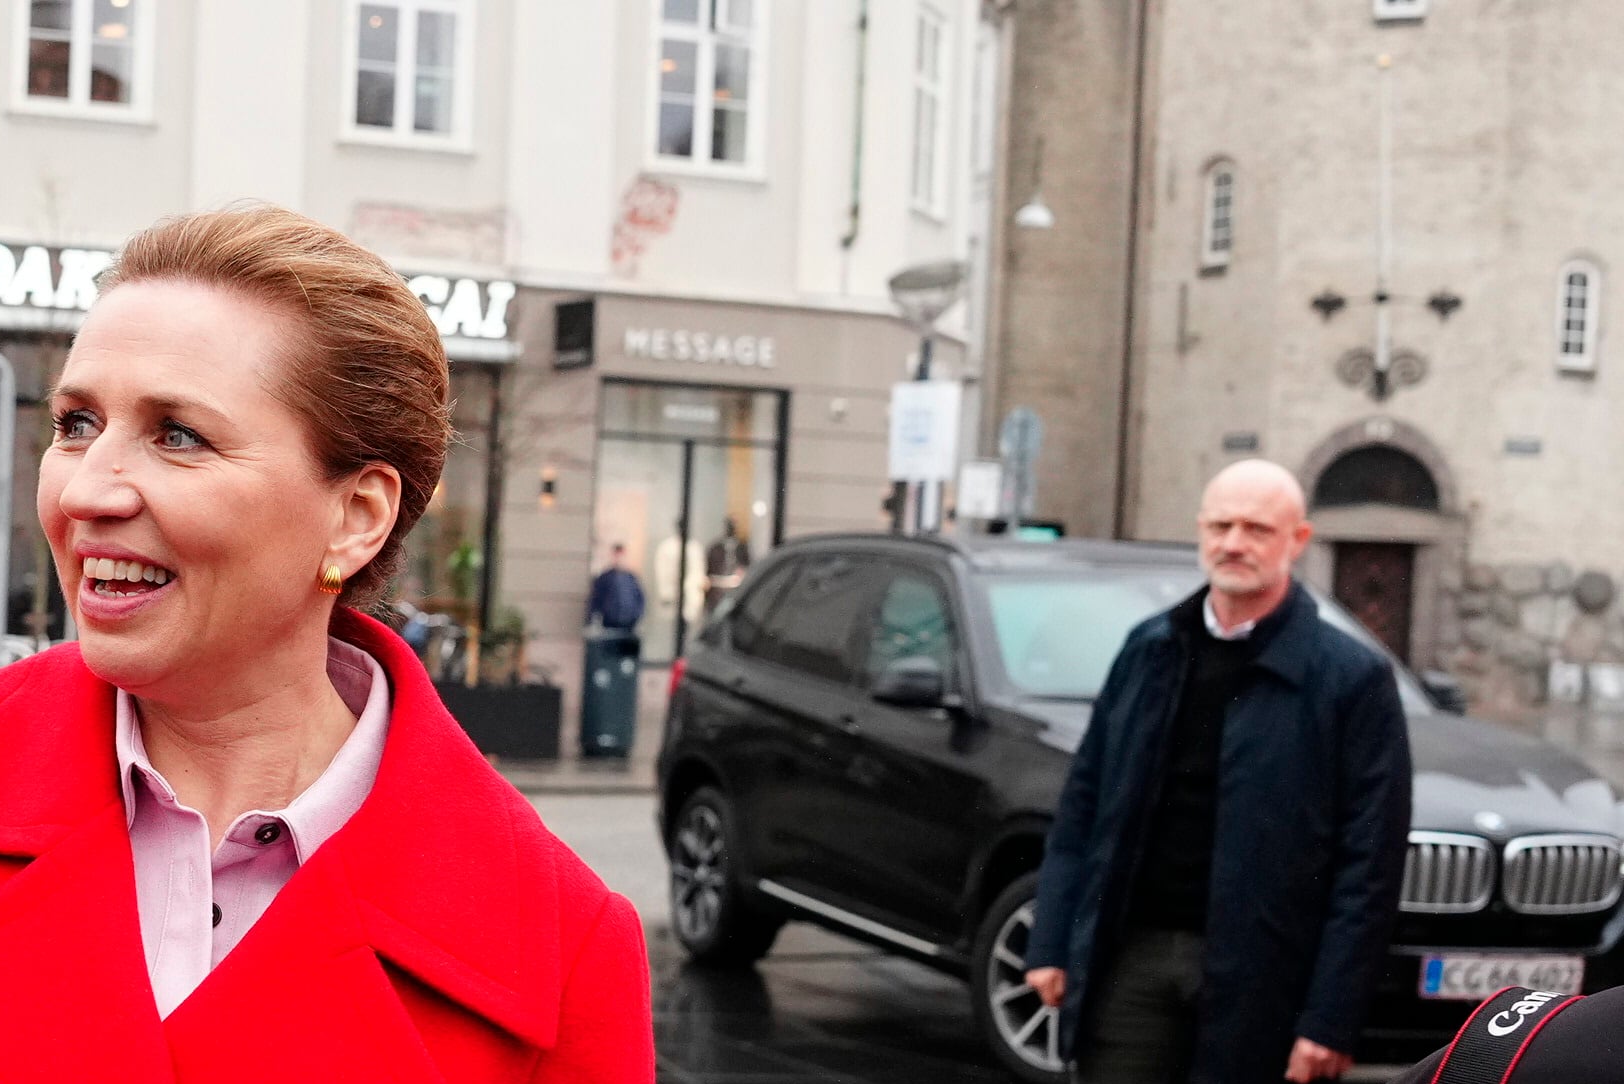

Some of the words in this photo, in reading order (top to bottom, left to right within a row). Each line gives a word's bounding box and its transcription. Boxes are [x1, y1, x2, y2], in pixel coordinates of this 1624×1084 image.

[407, 275, 515, 338] CAI
[625, 329, 776, 368] MESSAGE
[1487, 991, 1562, 1037] Can
